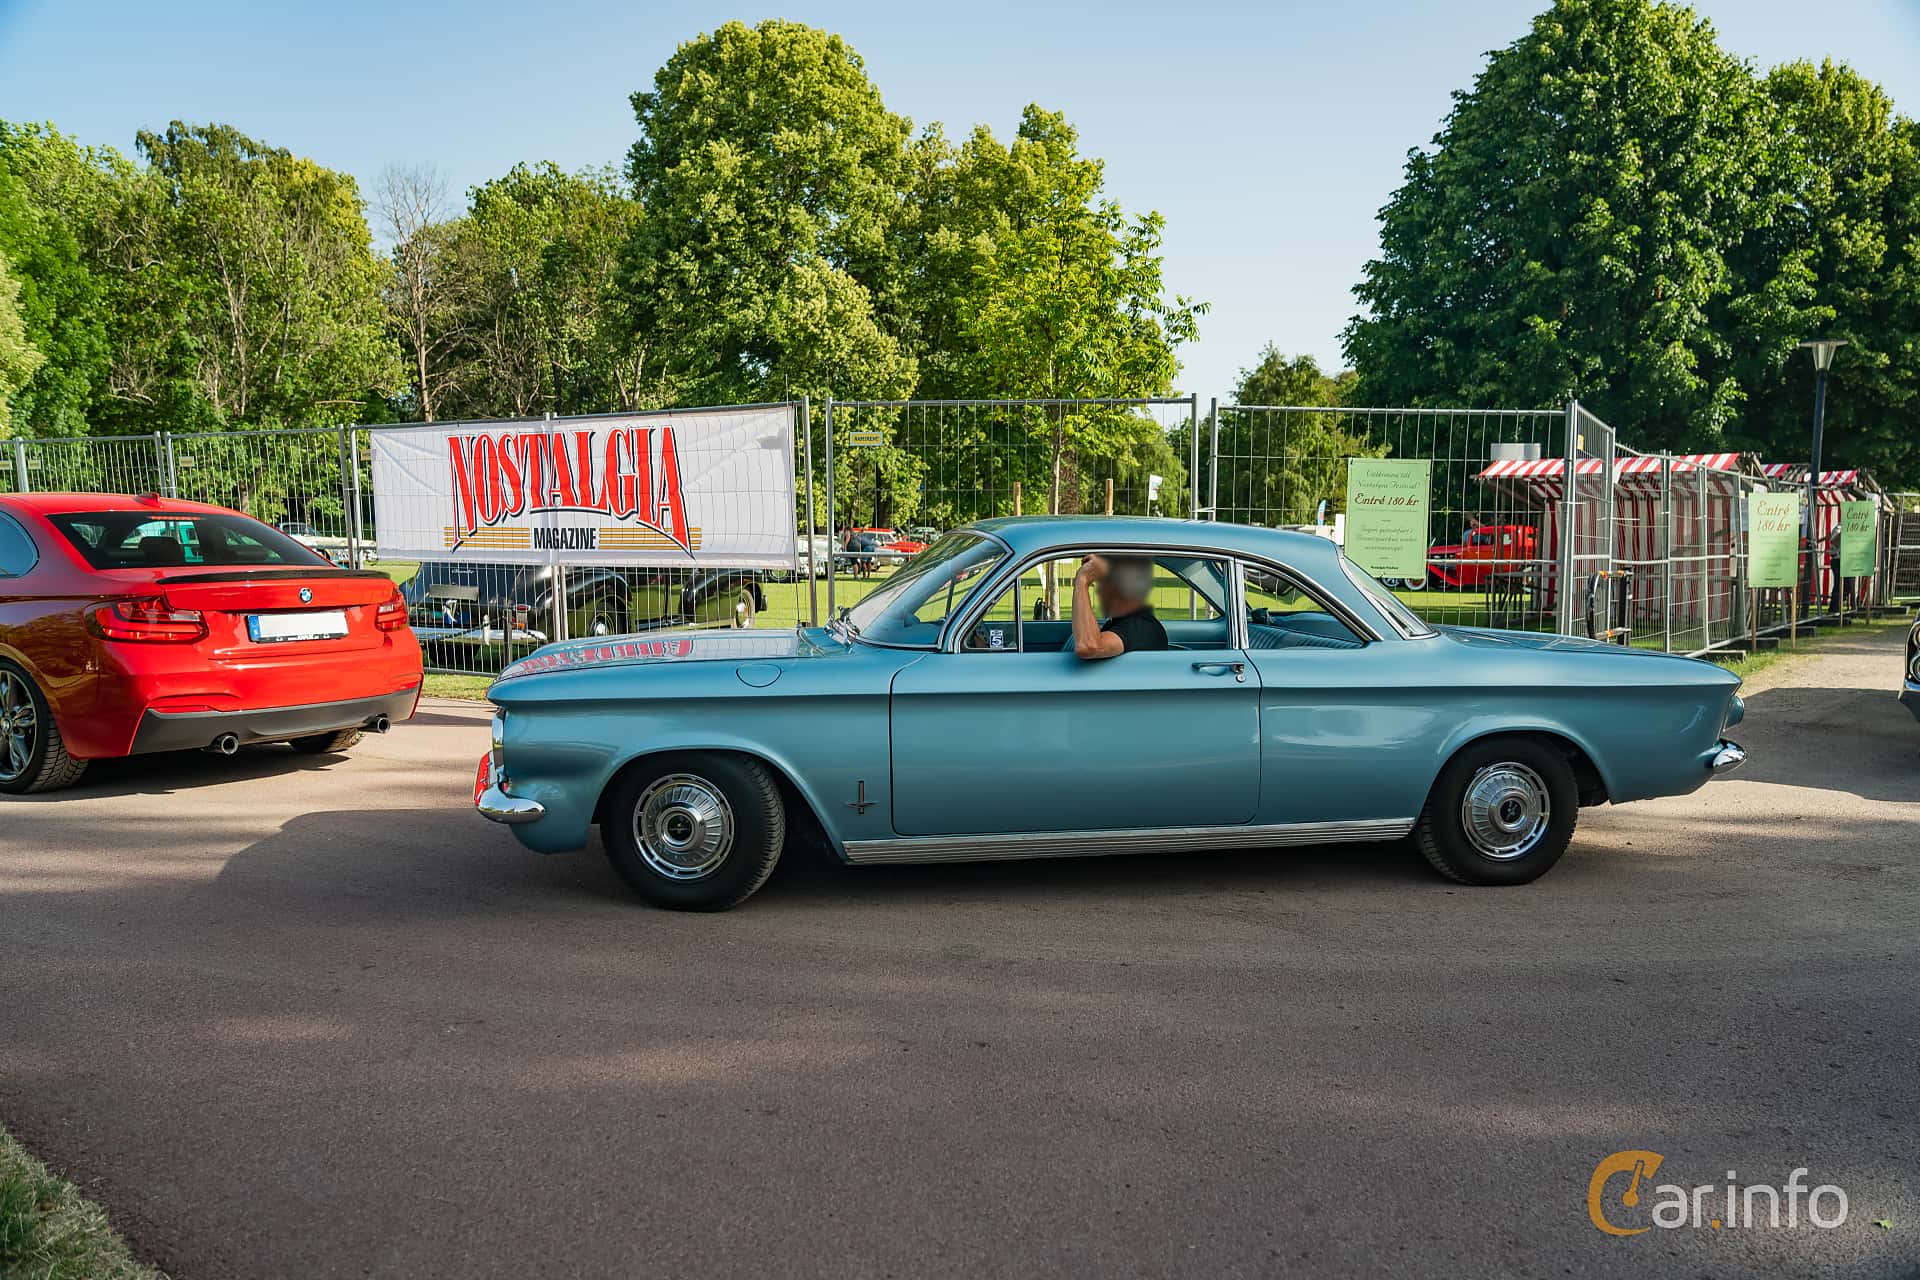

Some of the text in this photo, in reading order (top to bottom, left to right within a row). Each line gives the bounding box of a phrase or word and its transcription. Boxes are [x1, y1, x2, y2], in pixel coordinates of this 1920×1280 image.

[447, 426, 695, 560] NOSTALGIA
[1354, 492, 1386, 505] Entré
[1405, 494, 1420, 506] kr
[1756, 500, 1791, 517] Entré
[1756, 517, 1791, 532] 180 kr
[533, 527, 597, 550] MAGAZINE
